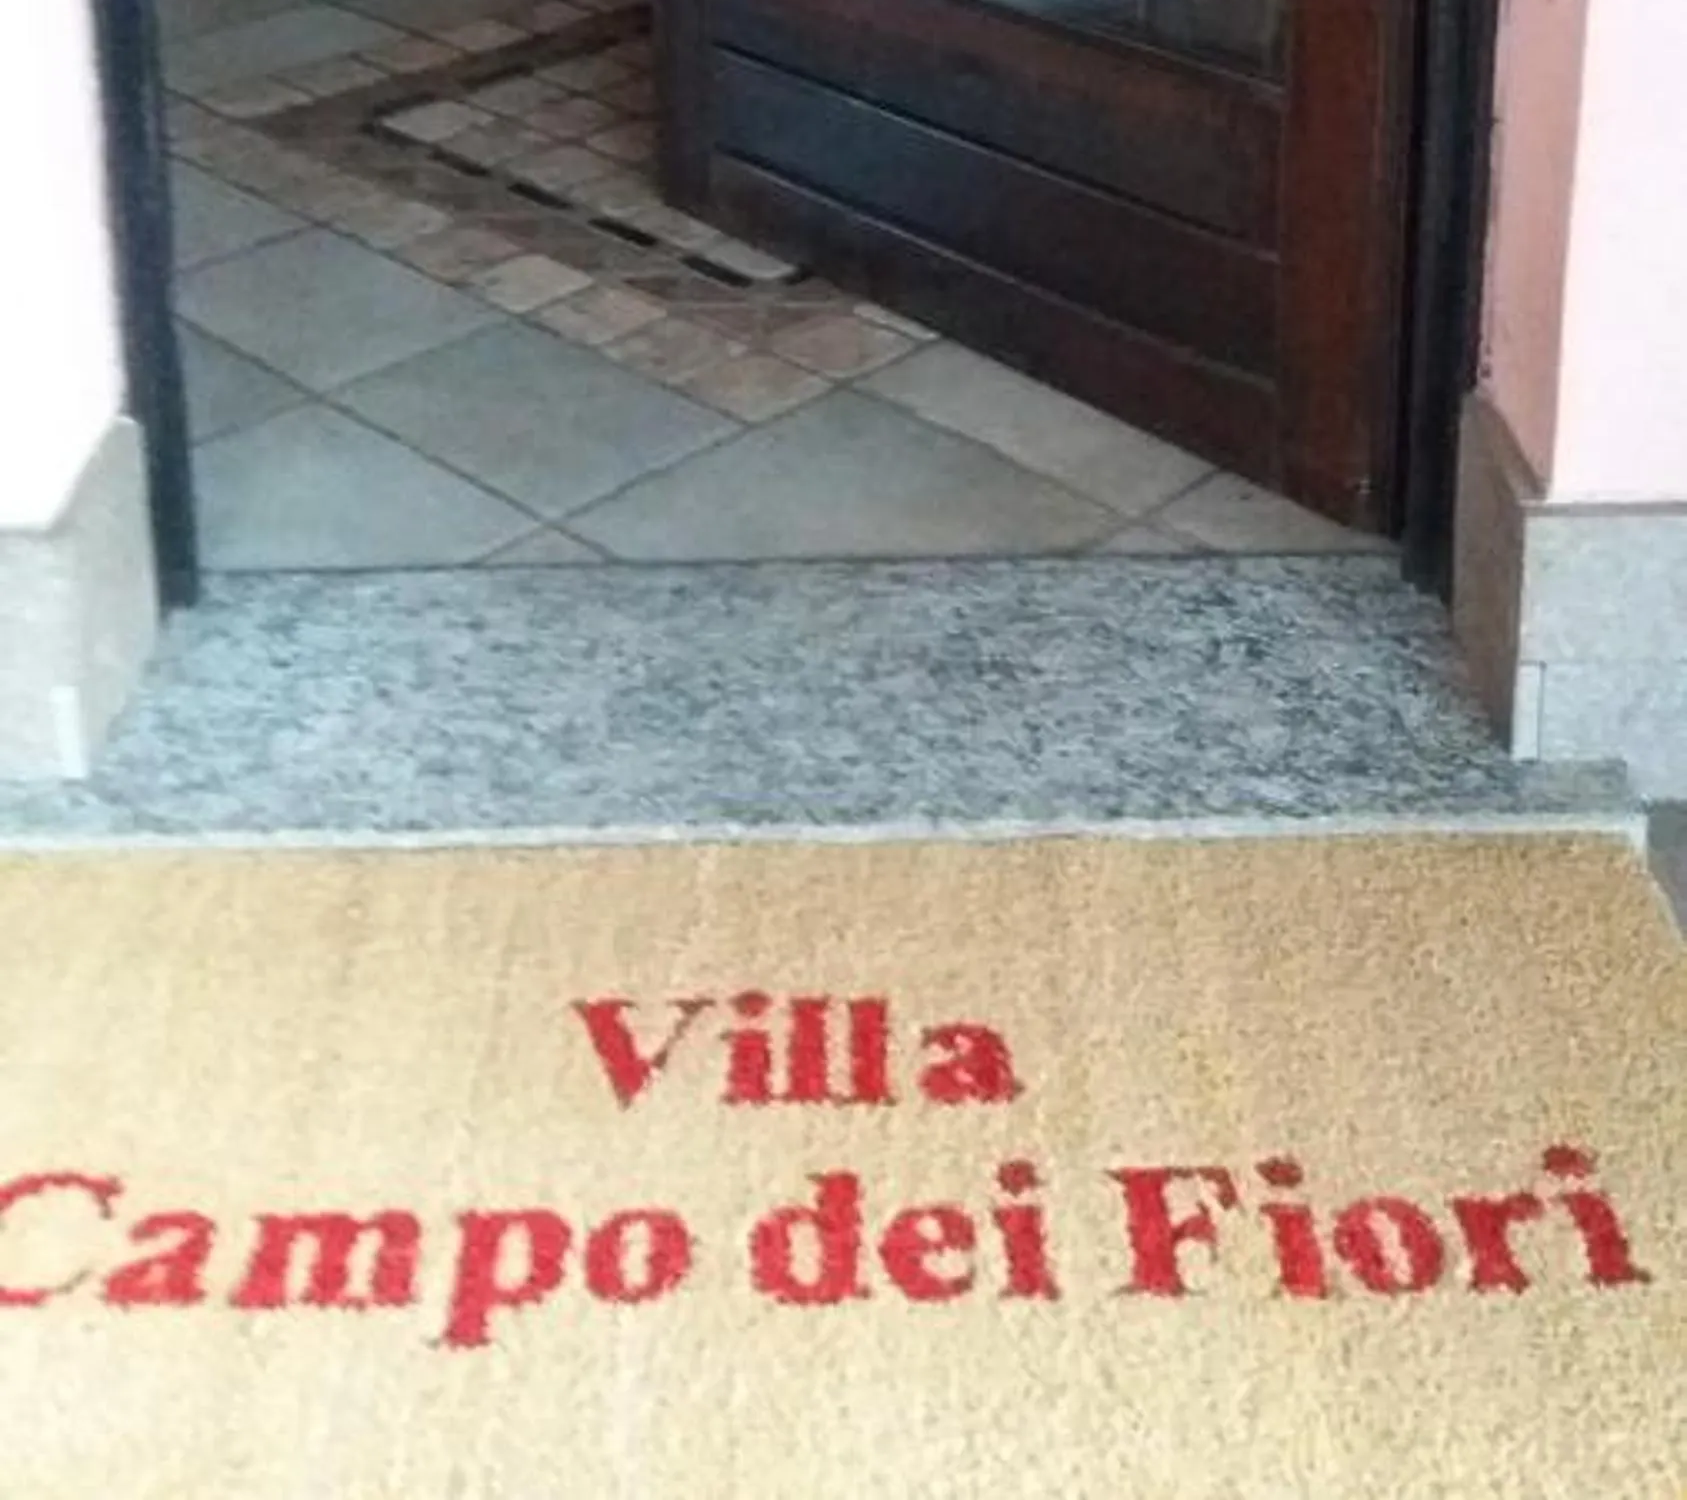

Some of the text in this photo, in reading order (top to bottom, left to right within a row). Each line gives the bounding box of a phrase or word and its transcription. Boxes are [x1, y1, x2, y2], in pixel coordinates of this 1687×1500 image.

[571, 992, 1025, 1110] Villa
[0, 1143, 1653, 1349] Campo dei Fiori
